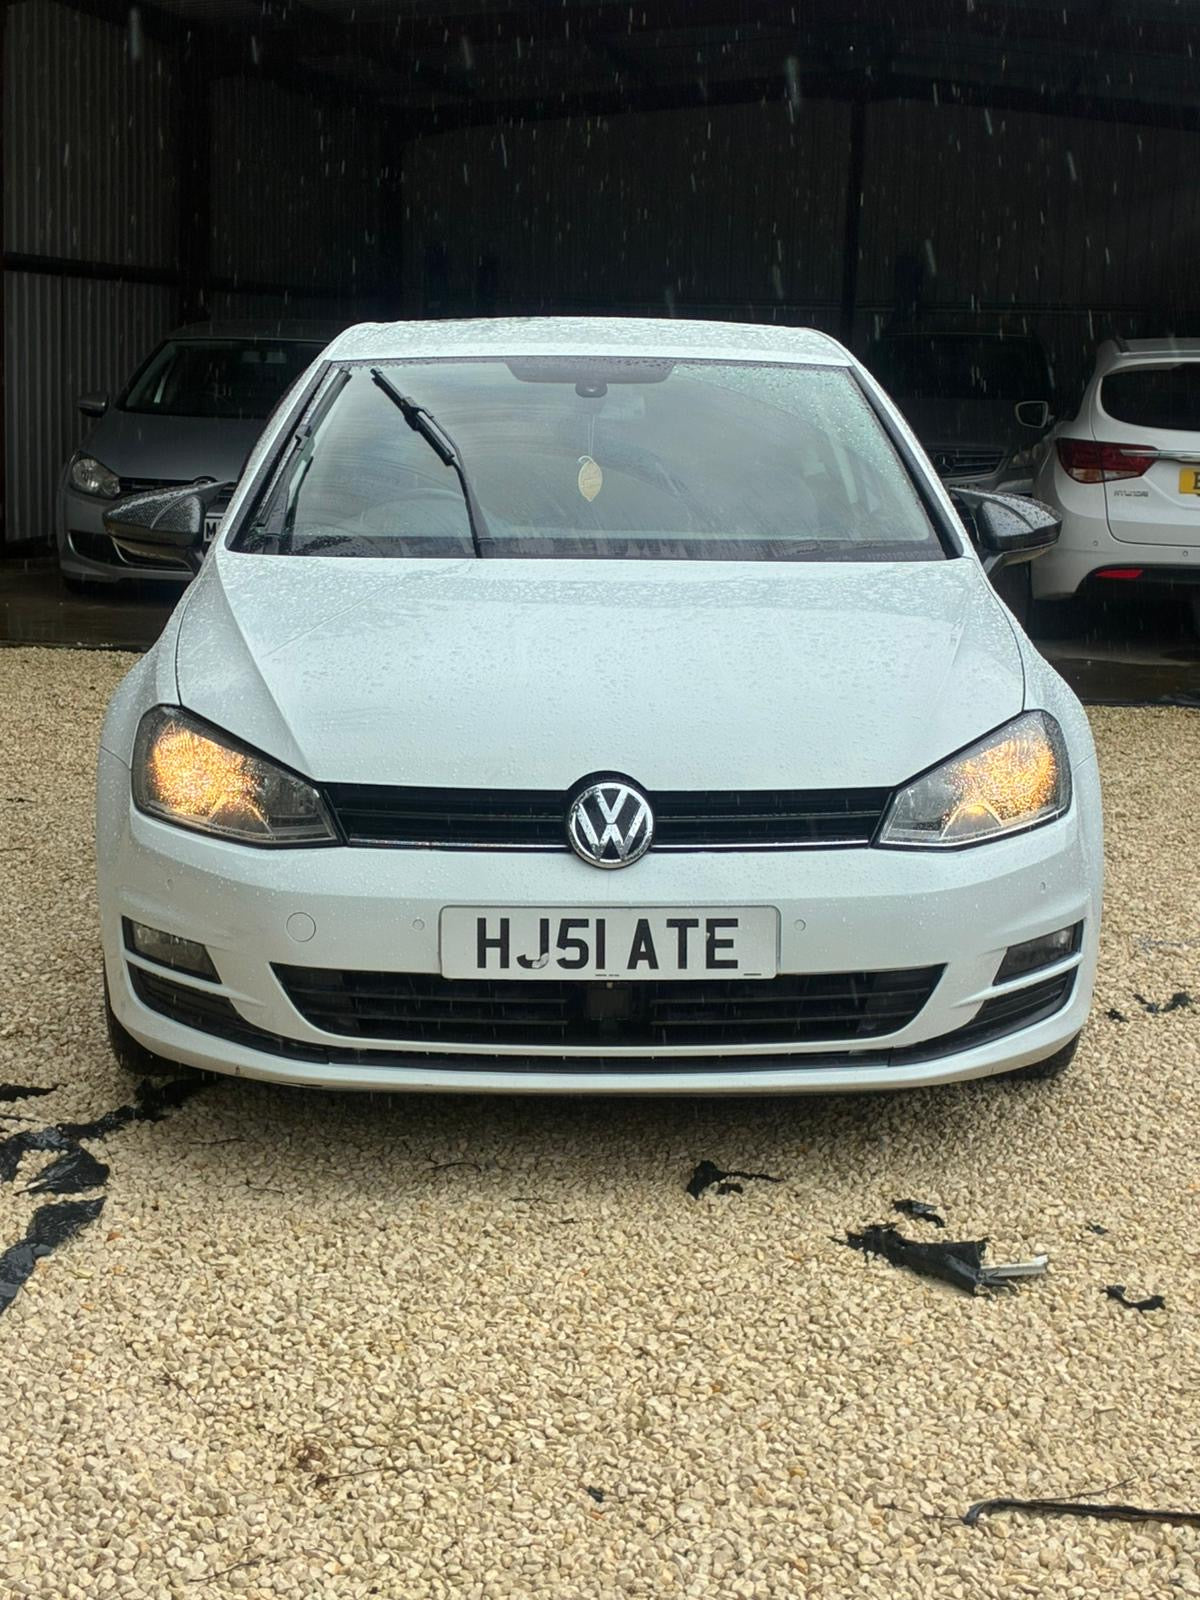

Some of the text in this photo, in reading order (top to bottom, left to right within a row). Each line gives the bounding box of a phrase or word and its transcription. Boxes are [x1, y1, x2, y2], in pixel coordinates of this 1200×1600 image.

[570, 784, 650, 864] VW
[476, 918, 739, 970] HJ51 ATE
